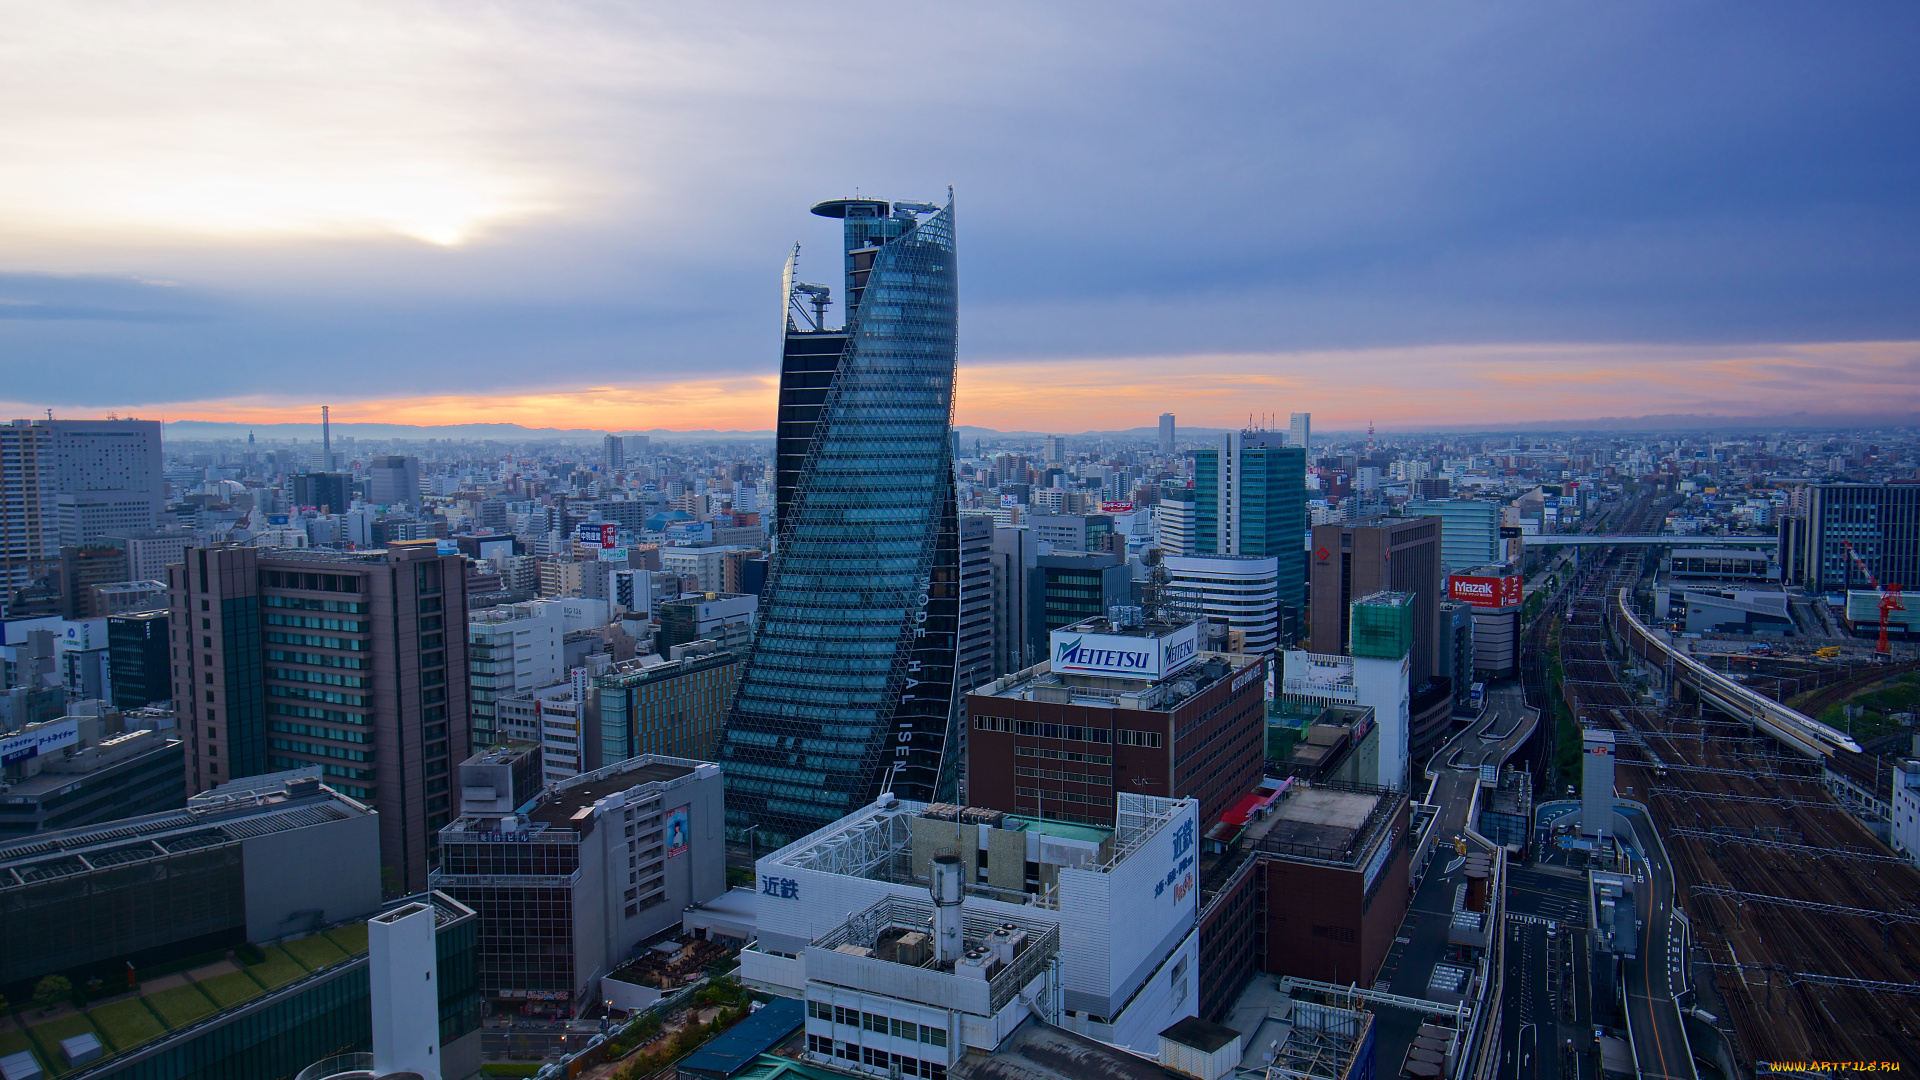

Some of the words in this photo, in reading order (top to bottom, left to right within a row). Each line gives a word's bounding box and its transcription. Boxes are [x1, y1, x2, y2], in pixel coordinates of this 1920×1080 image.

[1455, 581, 1493, 593] Mazak
[914, 576, 930, 638] MODE
[1056, 635, 1150, 669] MEITETSU
[1163, 637, 1195, 667] MEITETSU
[902, 660, 921, 705] HAL
[2, 737, 36, 751] アートネイチャー
[39, 730, 77, 746] アートネイチャー
[893, 723, 912, 772] ISEN
[1591, 746, 1607, 755] JR
[1173, 817, 1194, 862] 近鉄
[762, 874, 800, 901] 近鉄
